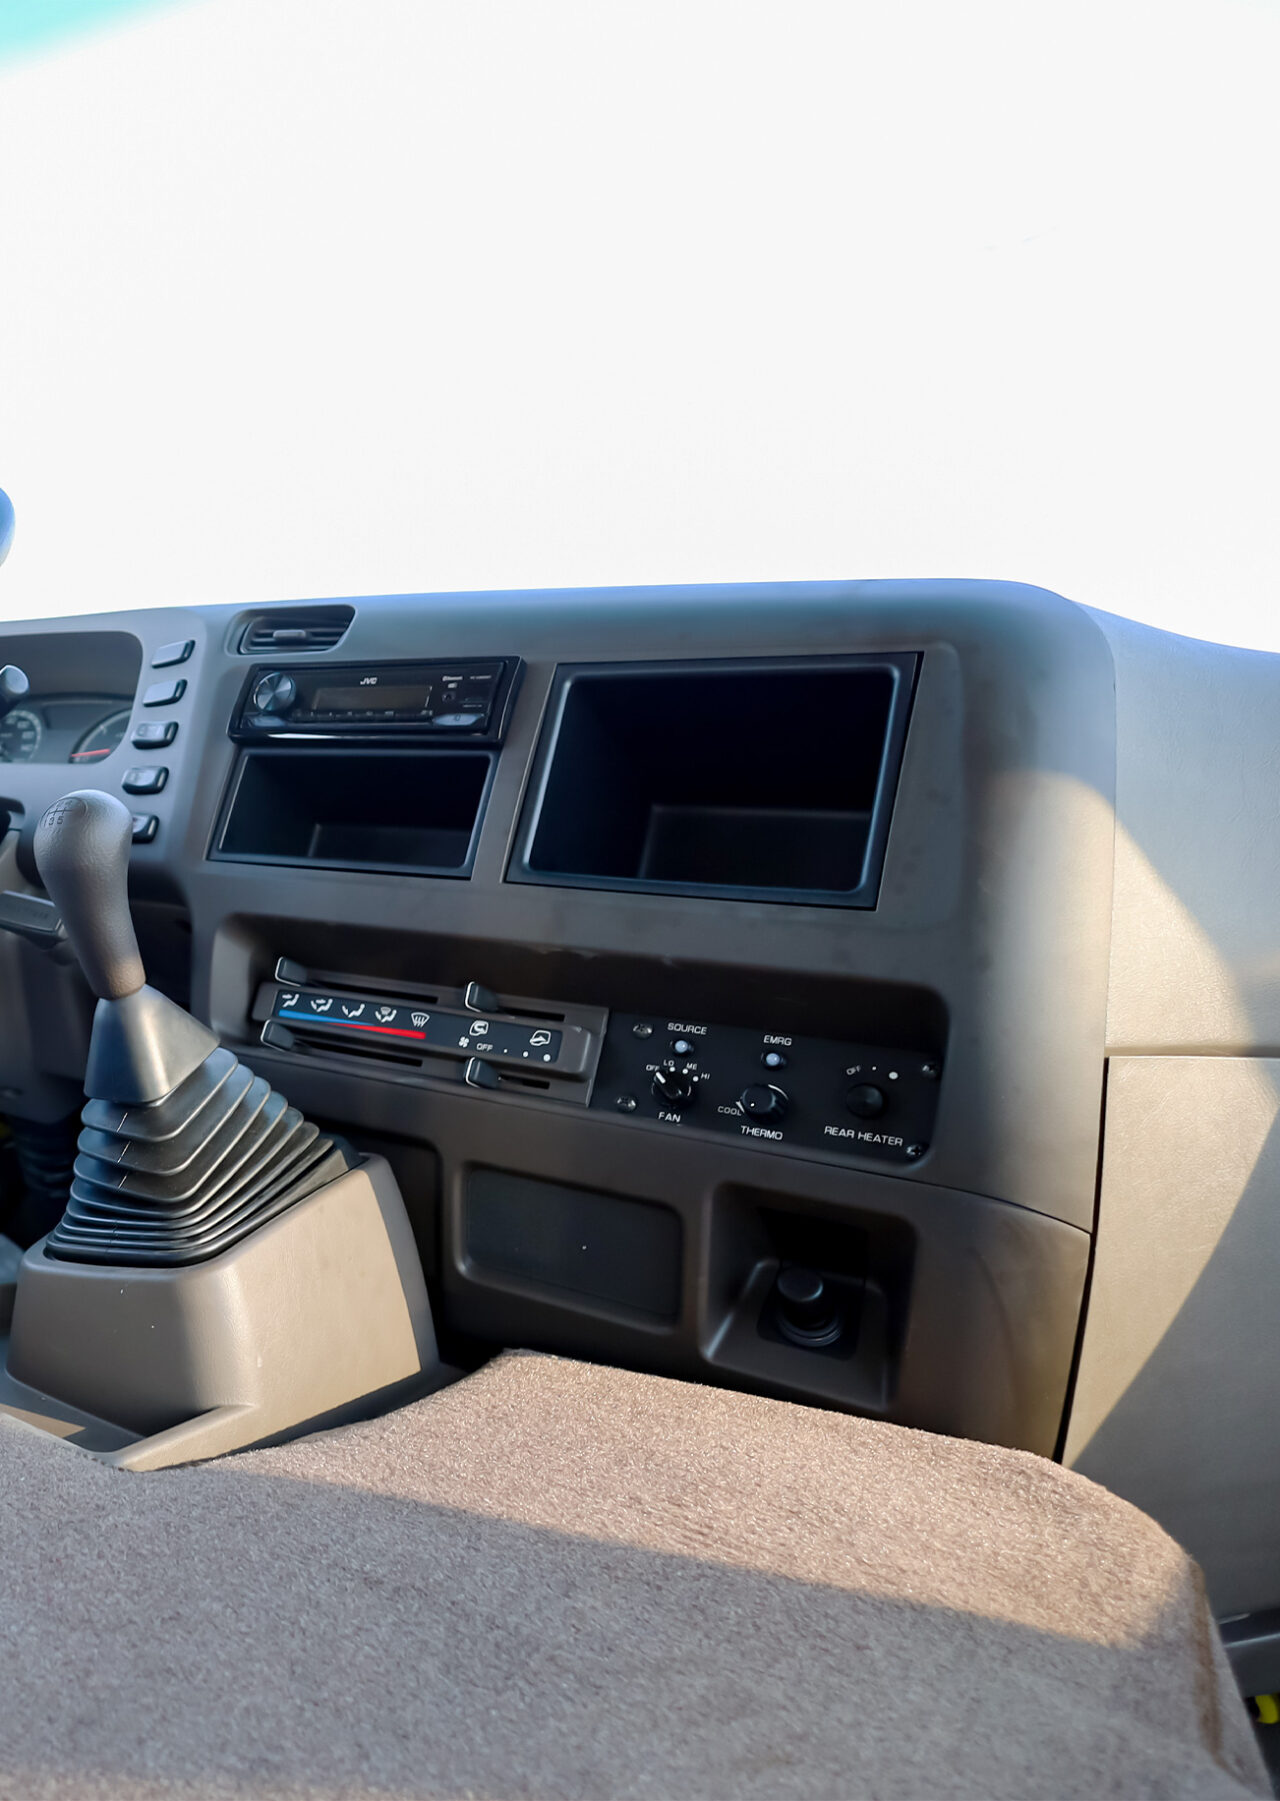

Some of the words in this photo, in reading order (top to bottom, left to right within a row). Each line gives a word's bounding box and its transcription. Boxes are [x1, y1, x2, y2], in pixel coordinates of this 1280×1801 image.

[360, 677, 378, 685] JVC
[48, 816, 55, 826] 3
[57, 815, 64, 825] 5
[667, 1022, 708, 1035] SOURCE
[763, 1035, 792, 1046] EMRG
[476, 1043, 493, 1052] OFF
[646, 1064, 660, 1073] OFF
[846, 1065, 861, 1075] OFF
[701, 1072, 710, 1080] HI
[717, 1106, 742, 1116] COOL
[658, 1111, 681, 1123] FAN
[740, 1125, 784, 1140] THERMO
[824, 1126, 855, 1139] REAR
[857, 1131, 903, 1146] HEATER
